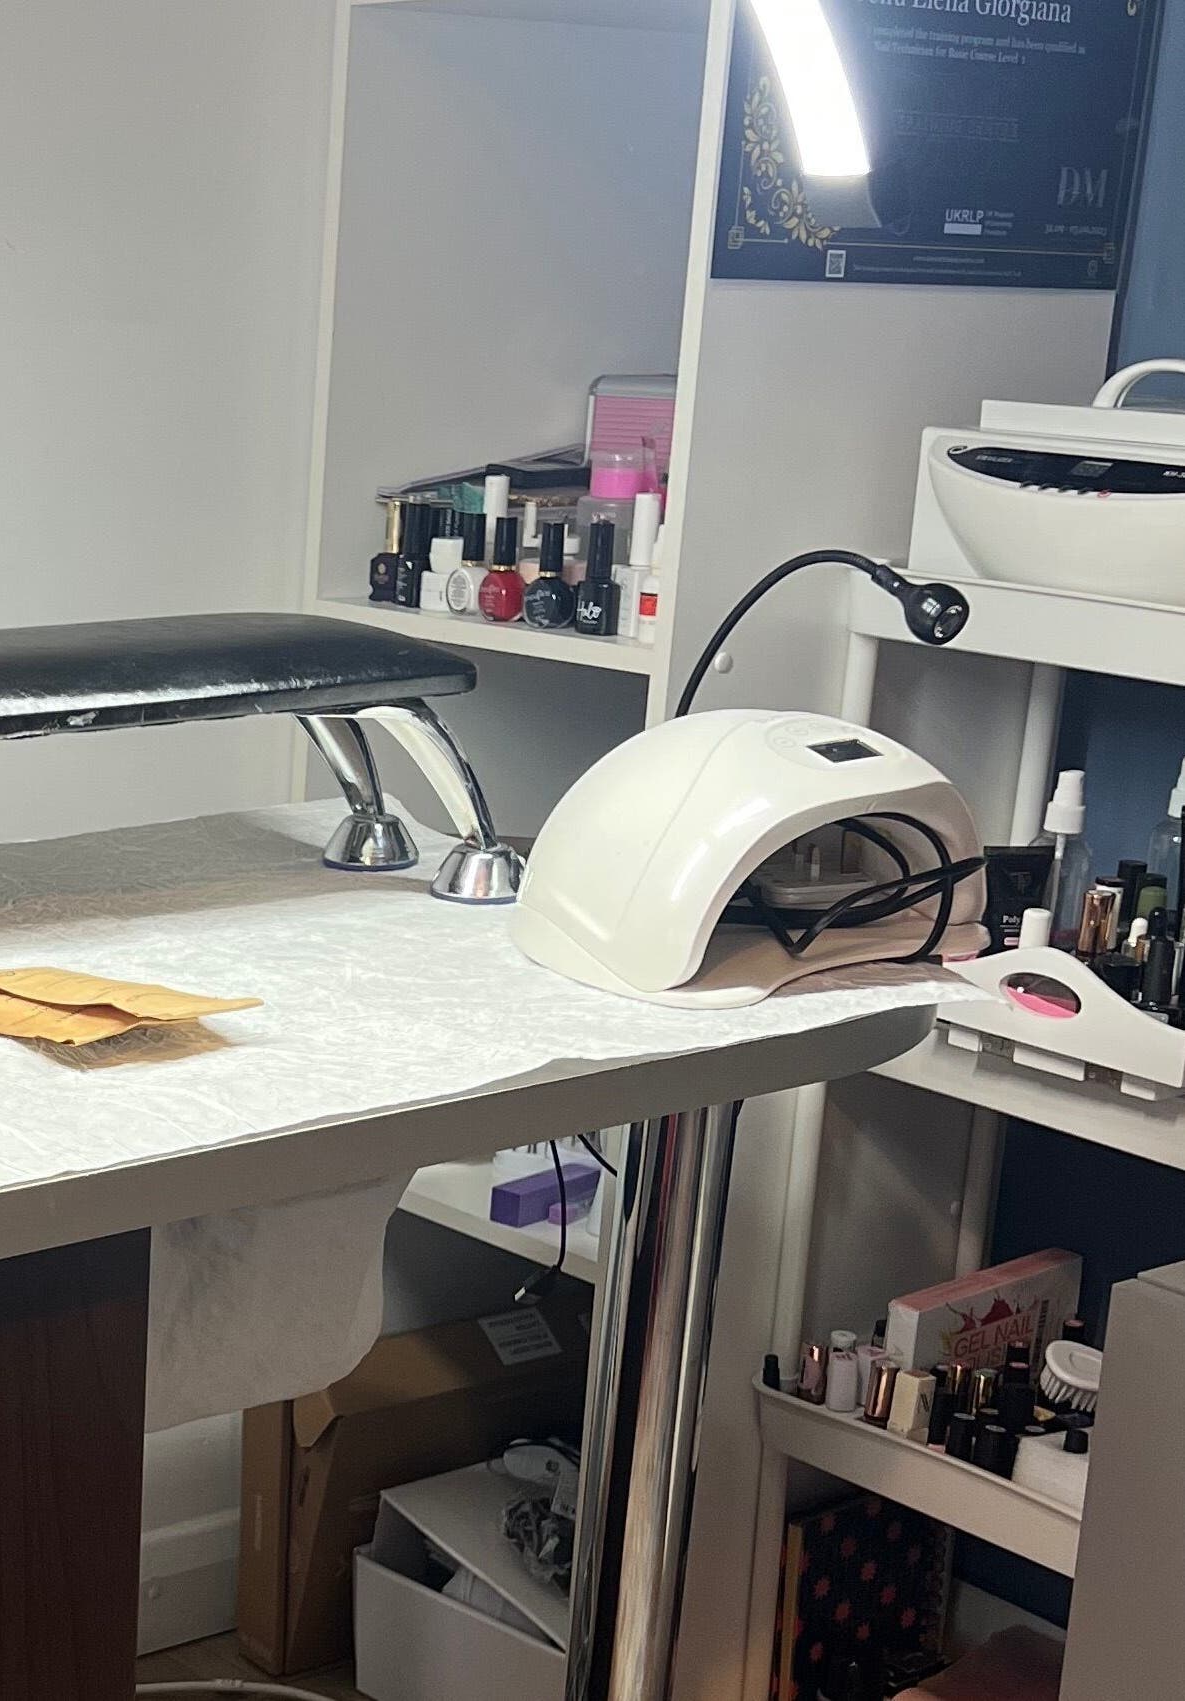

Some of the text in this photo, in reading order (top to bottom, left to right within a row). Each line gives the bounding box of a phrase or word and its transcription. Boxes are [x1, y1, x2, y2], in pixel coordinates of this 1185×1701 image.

[975, 0, 1072, 26] Giorgiana
[945, 209, 984, 222] UKRLP
[954, 1314, 1034, 1358] GEL NAIL
